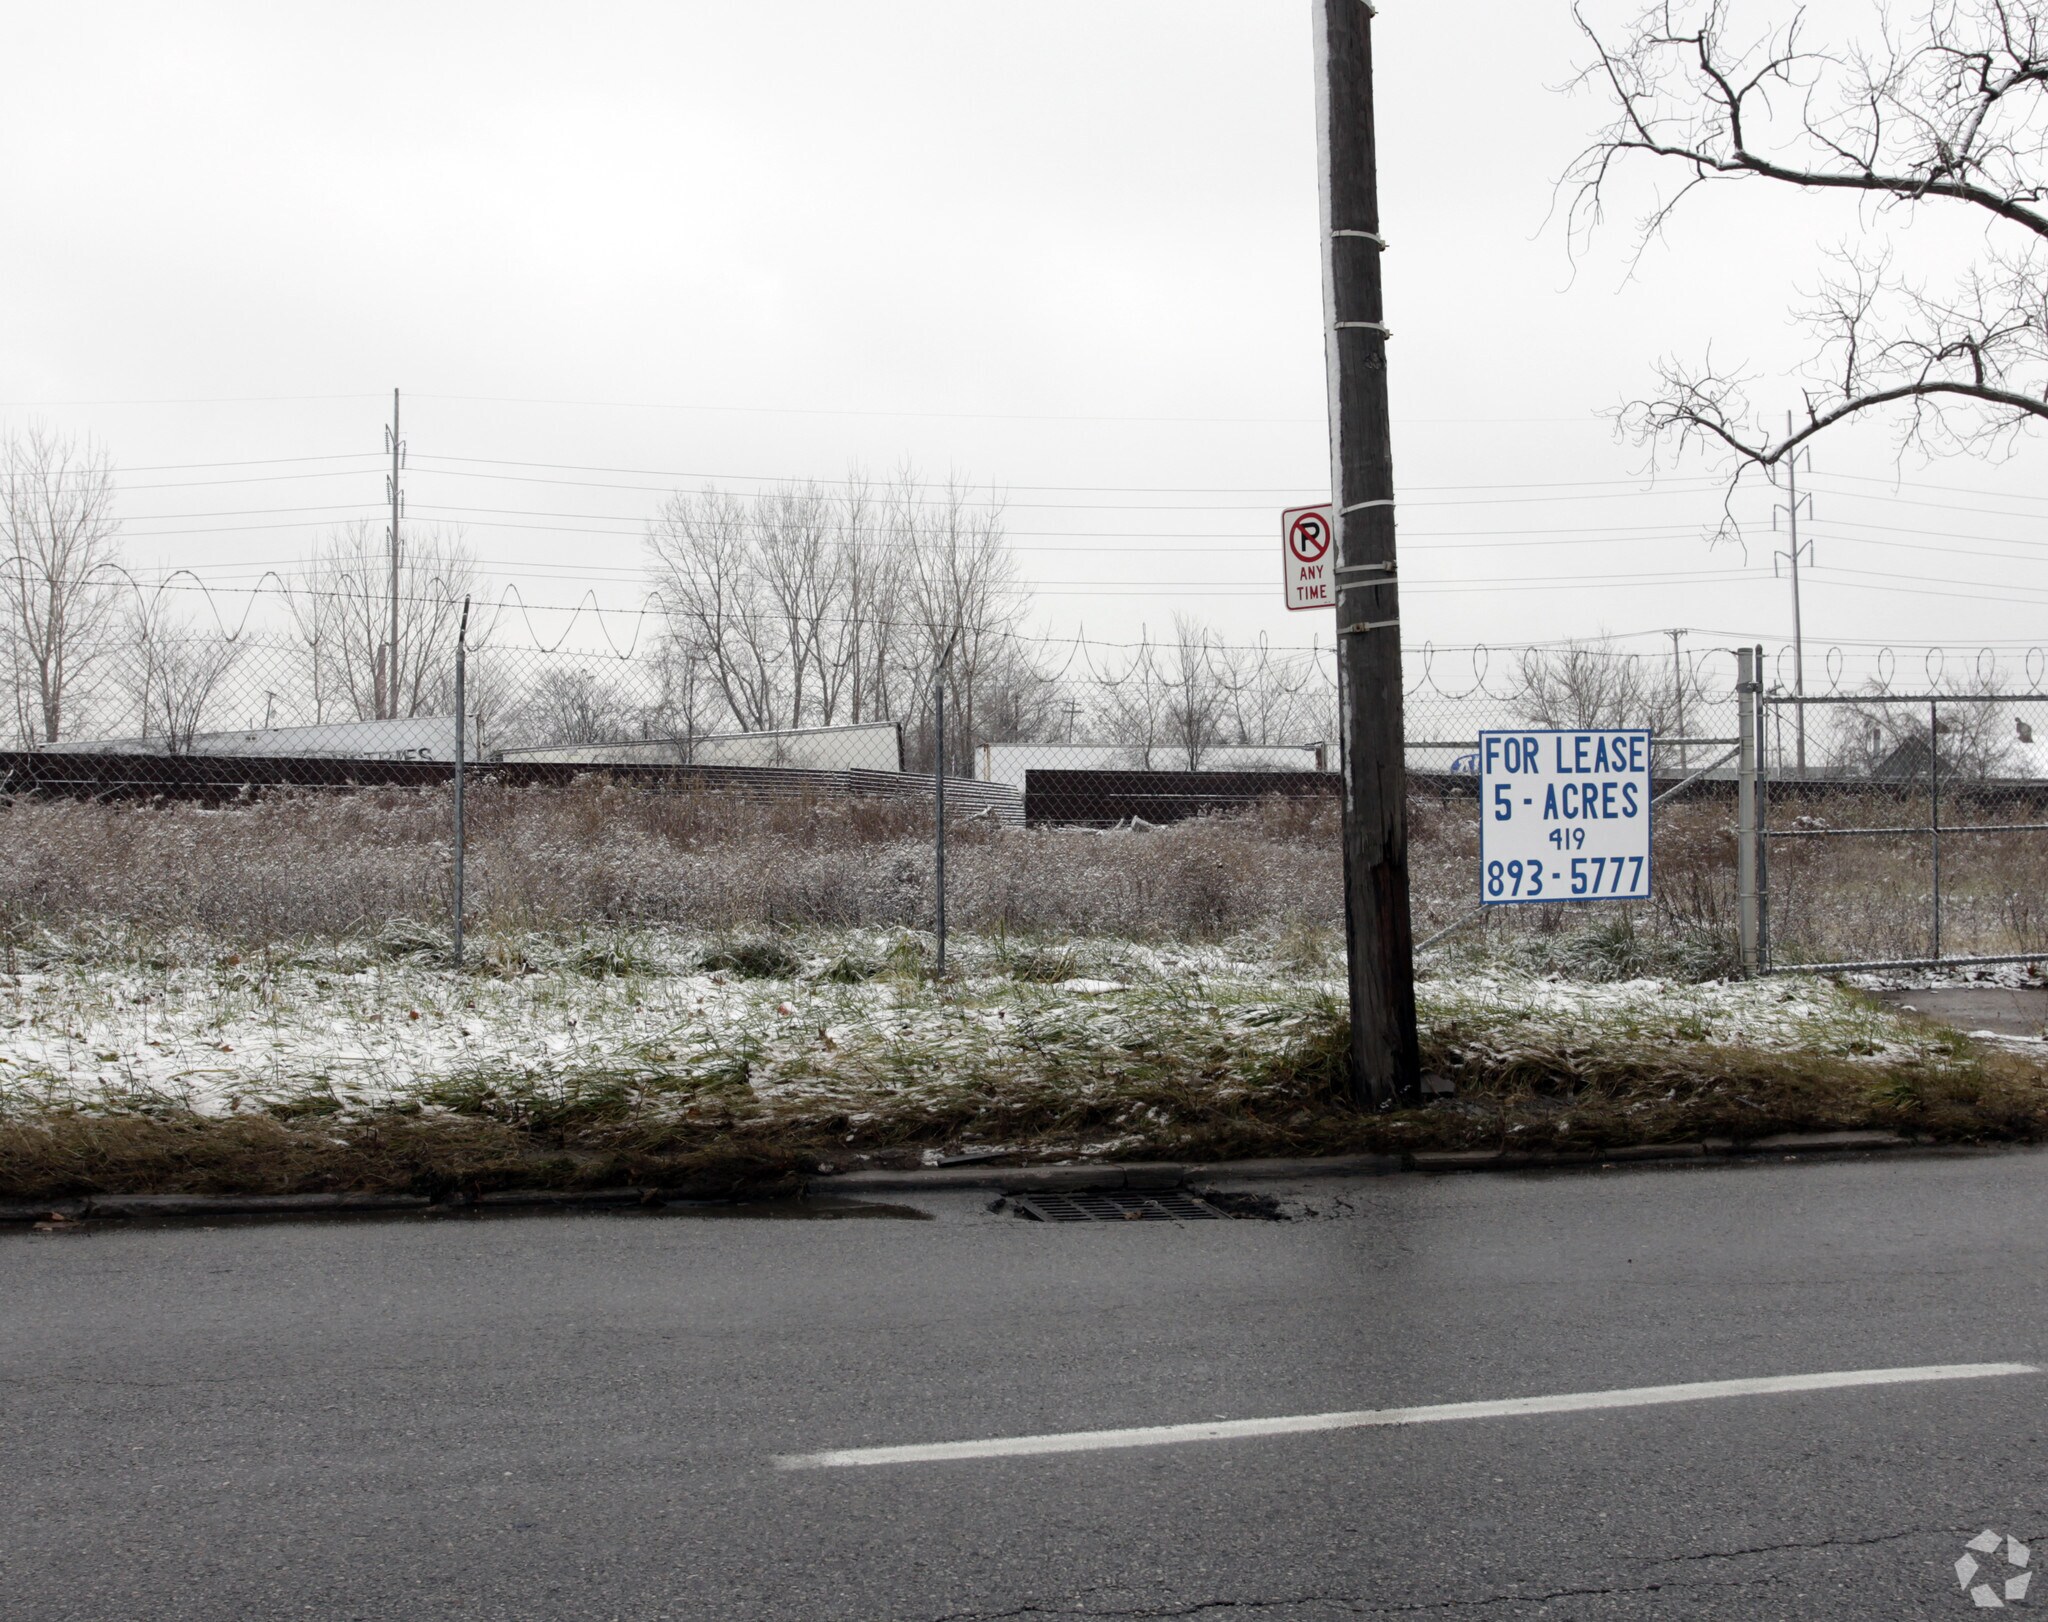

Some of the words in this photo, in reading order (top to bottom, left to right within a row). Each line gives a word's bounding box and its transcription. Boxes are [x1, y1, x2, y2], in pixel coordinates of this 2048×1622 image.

[1300, 565, 1324, 581] ANY
[1297, 584, 1327, 601] TIME
[1486, 737, 1539, 774] FOR
[1556, 736, 1645, 773] LEASE
[1549, 827, 1585, 850] 419
